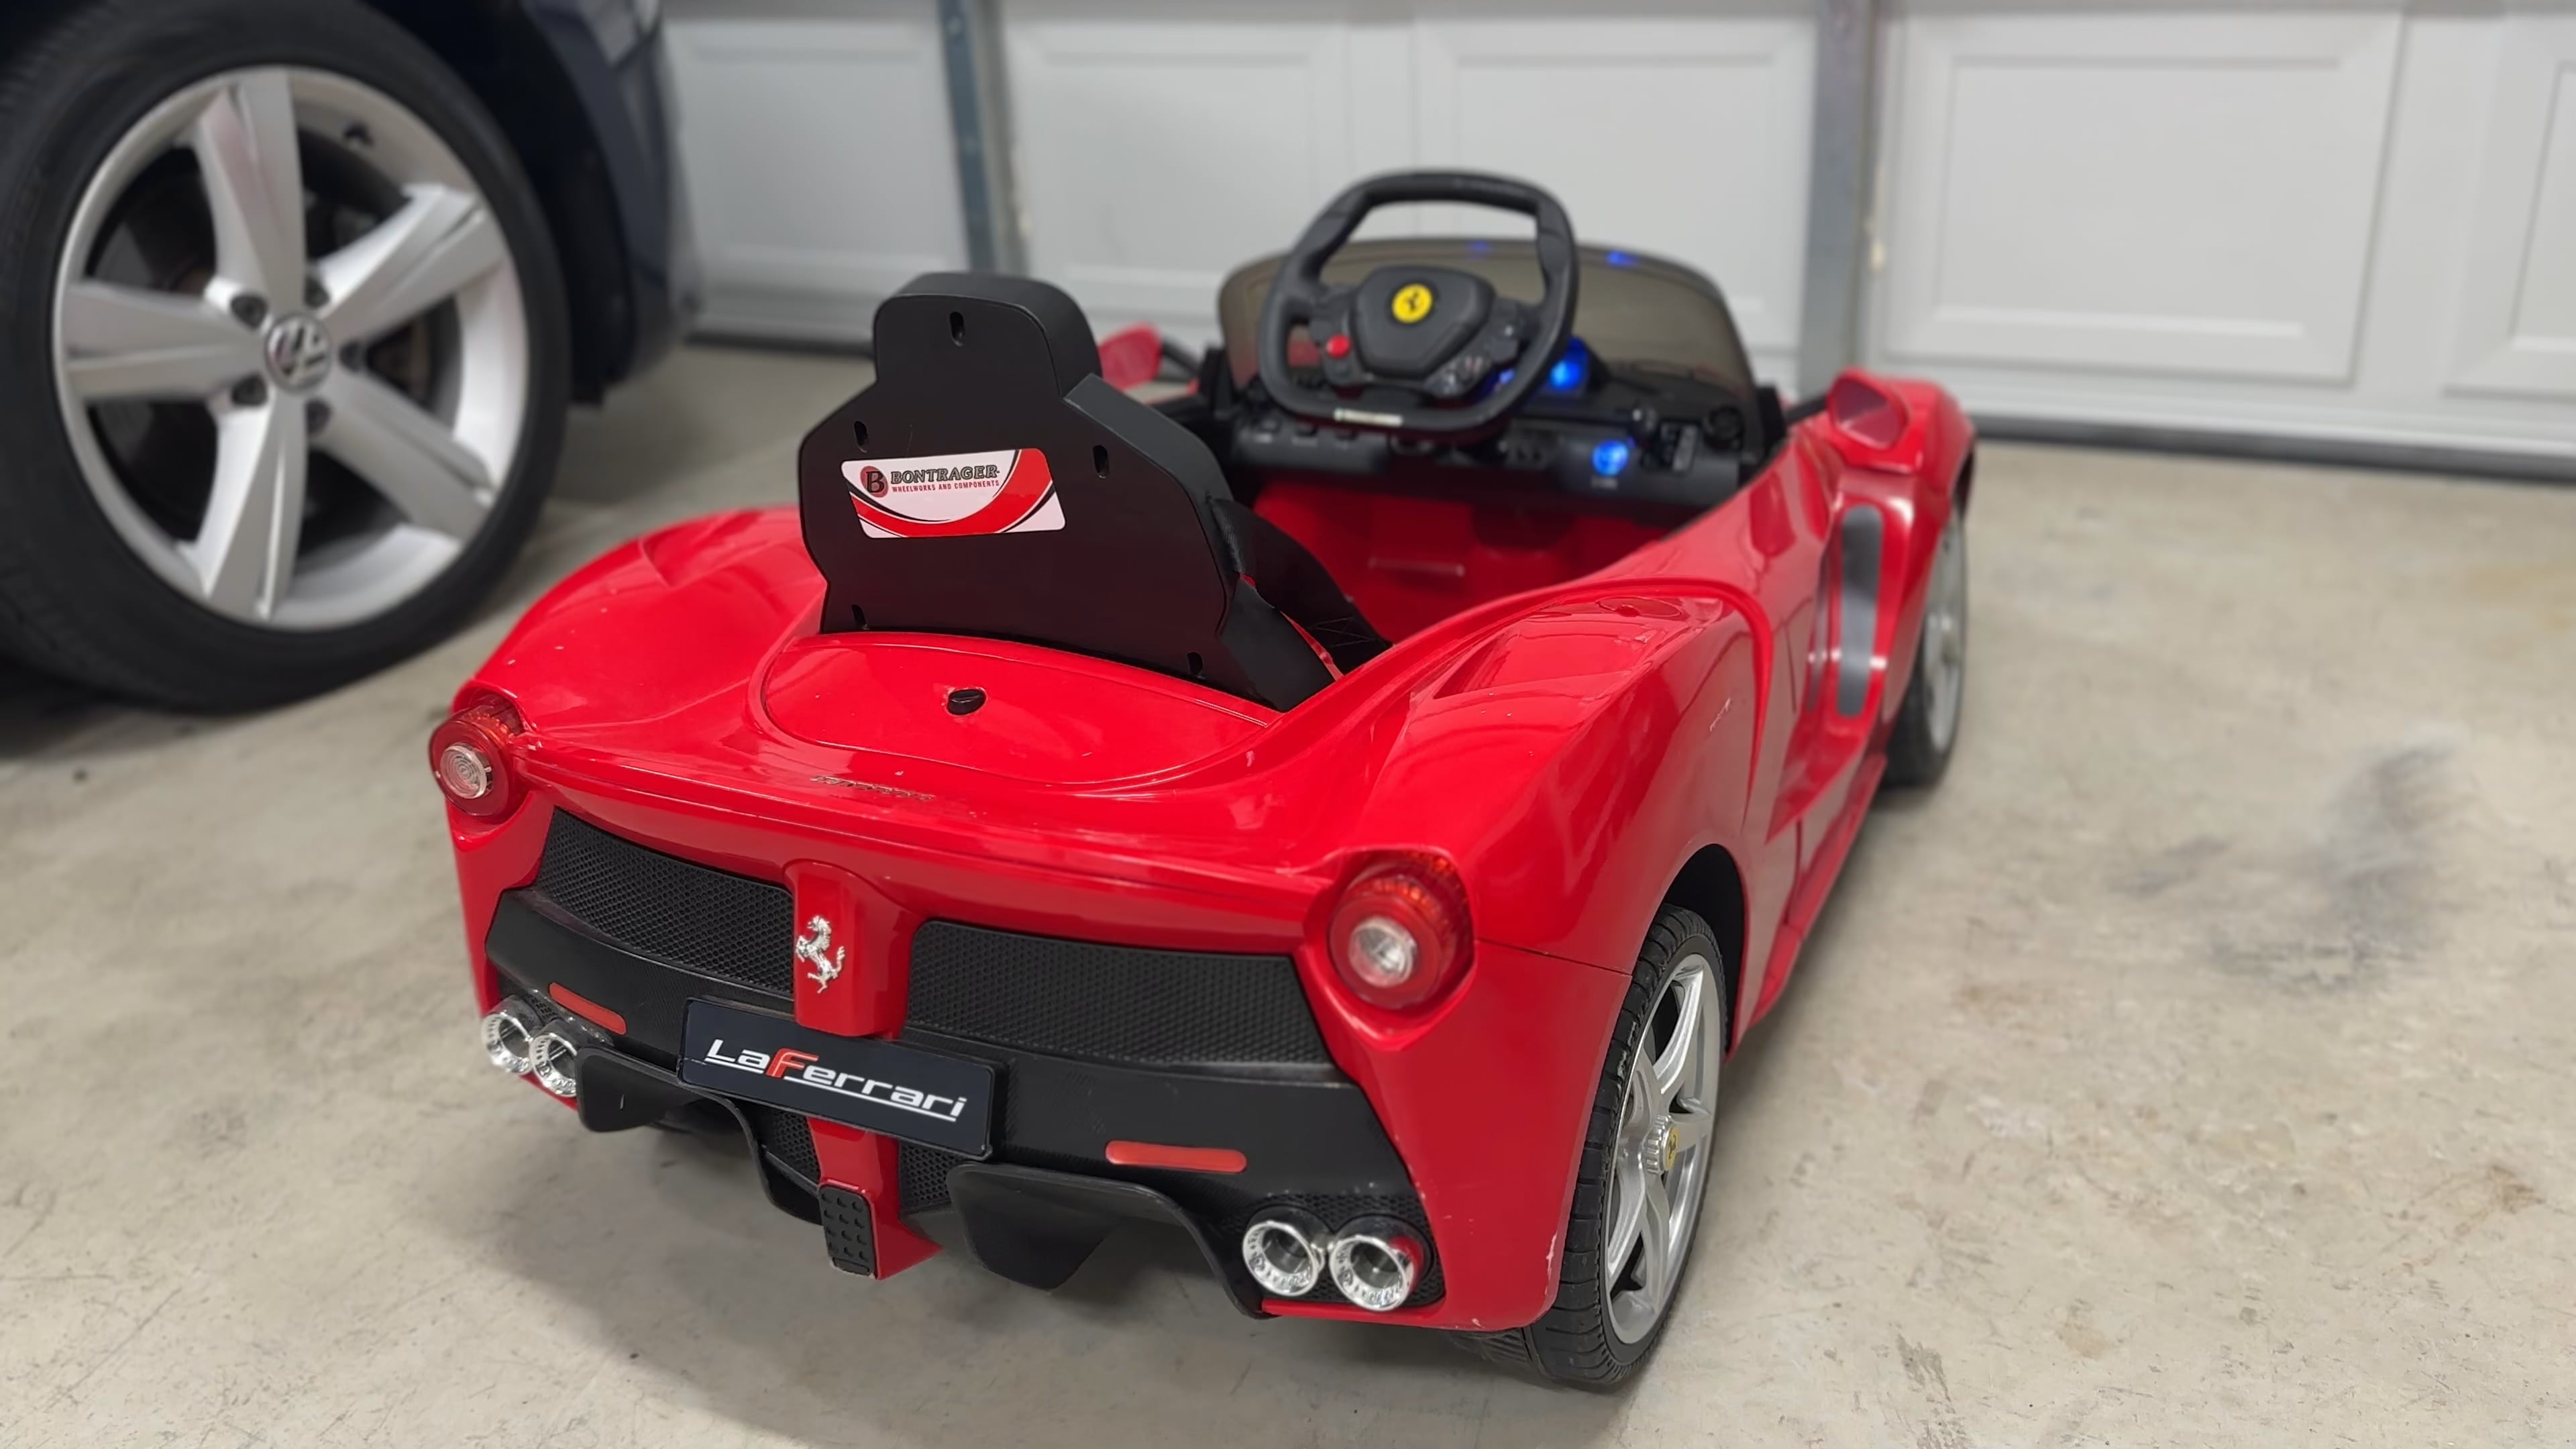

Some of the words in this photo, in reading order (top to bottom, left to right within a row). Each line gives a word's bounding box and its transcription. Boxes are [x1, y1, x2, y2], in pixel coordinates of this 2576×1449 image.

[865, 470, 885, 493] B
[891, 465, 998, 484] BONTRAGER
[892, 484, 936, 493] WHEELWORKS
[939, 482, 951, 490] AND
[954, 480, 1000, 489] COMPONENTS
[704, 1038, 967, 1118] LaFerrari
